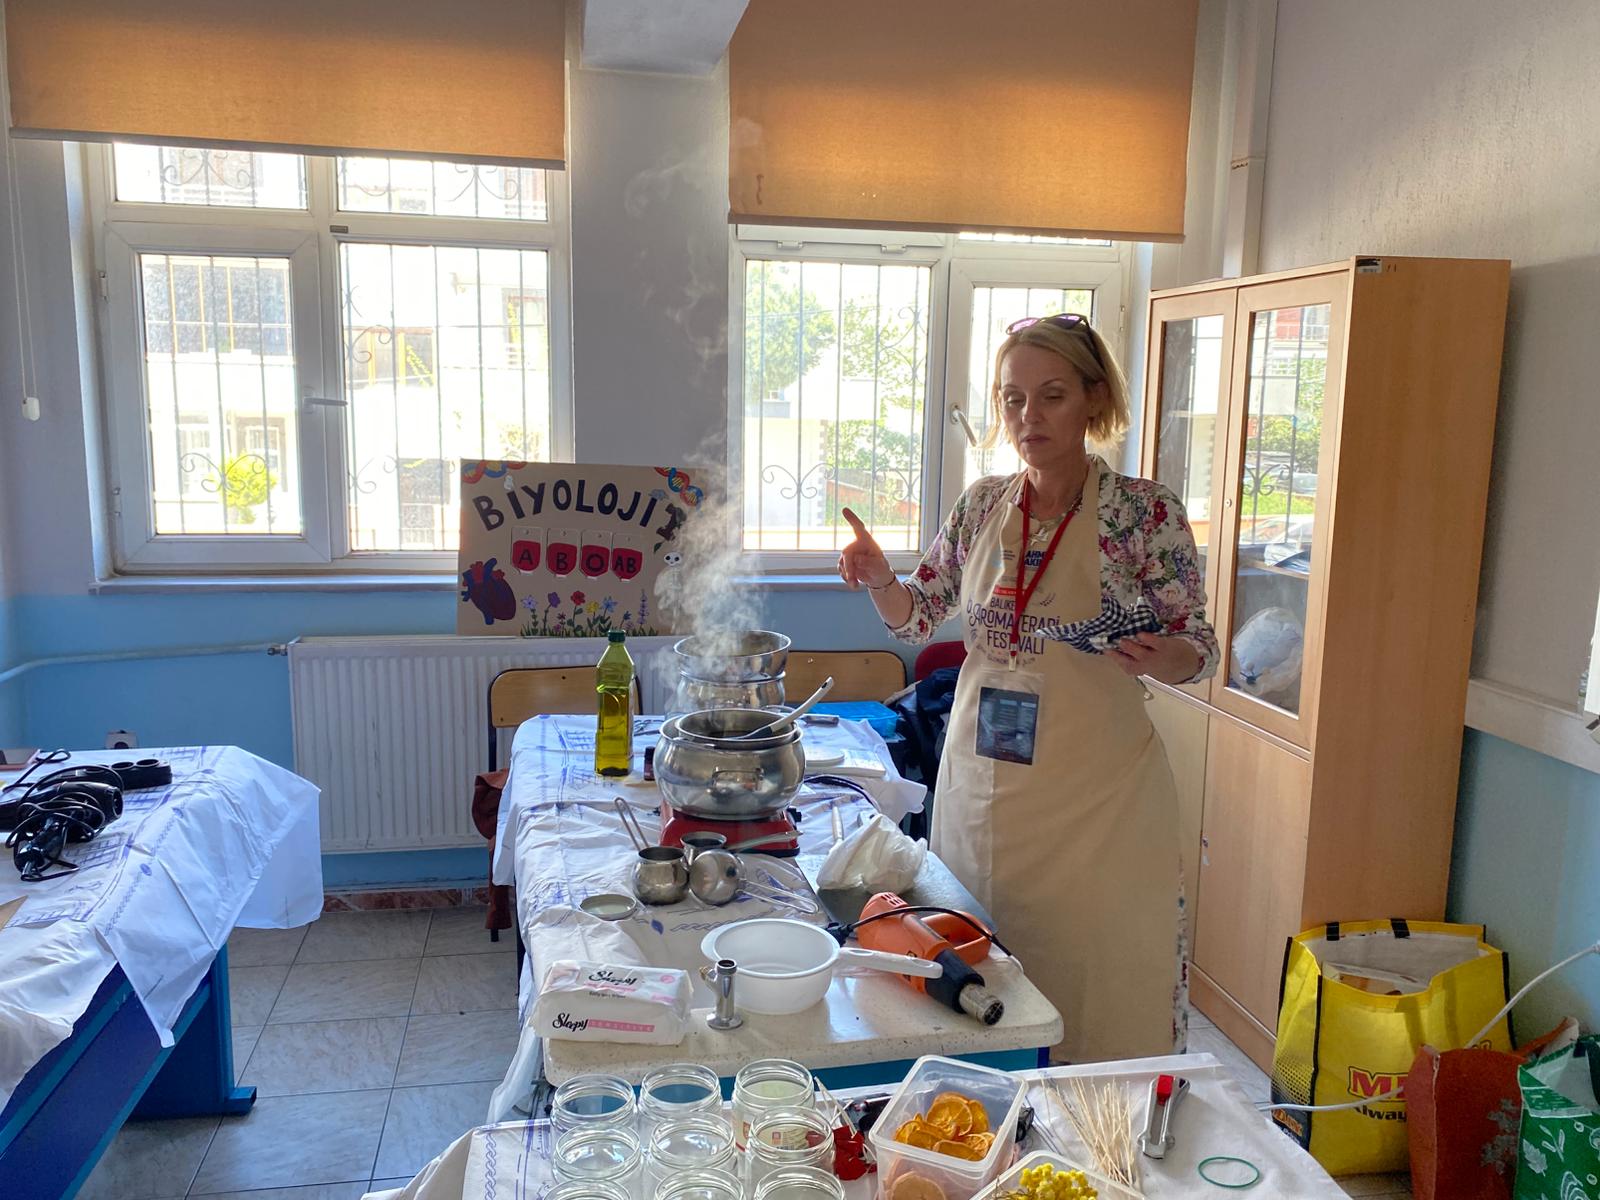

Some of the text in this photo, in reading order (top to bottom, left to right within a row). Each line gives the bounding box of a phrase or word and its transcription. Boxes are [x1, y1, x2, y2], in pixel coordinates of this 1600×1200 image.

[518, 549, 533, 565] A
[556, 552, 569, 571] B
[614, 556, 637, 573] AB
[989, 597, 1022, 612] BALIKE
[552, 1012, 589, 1033] Sleepy
